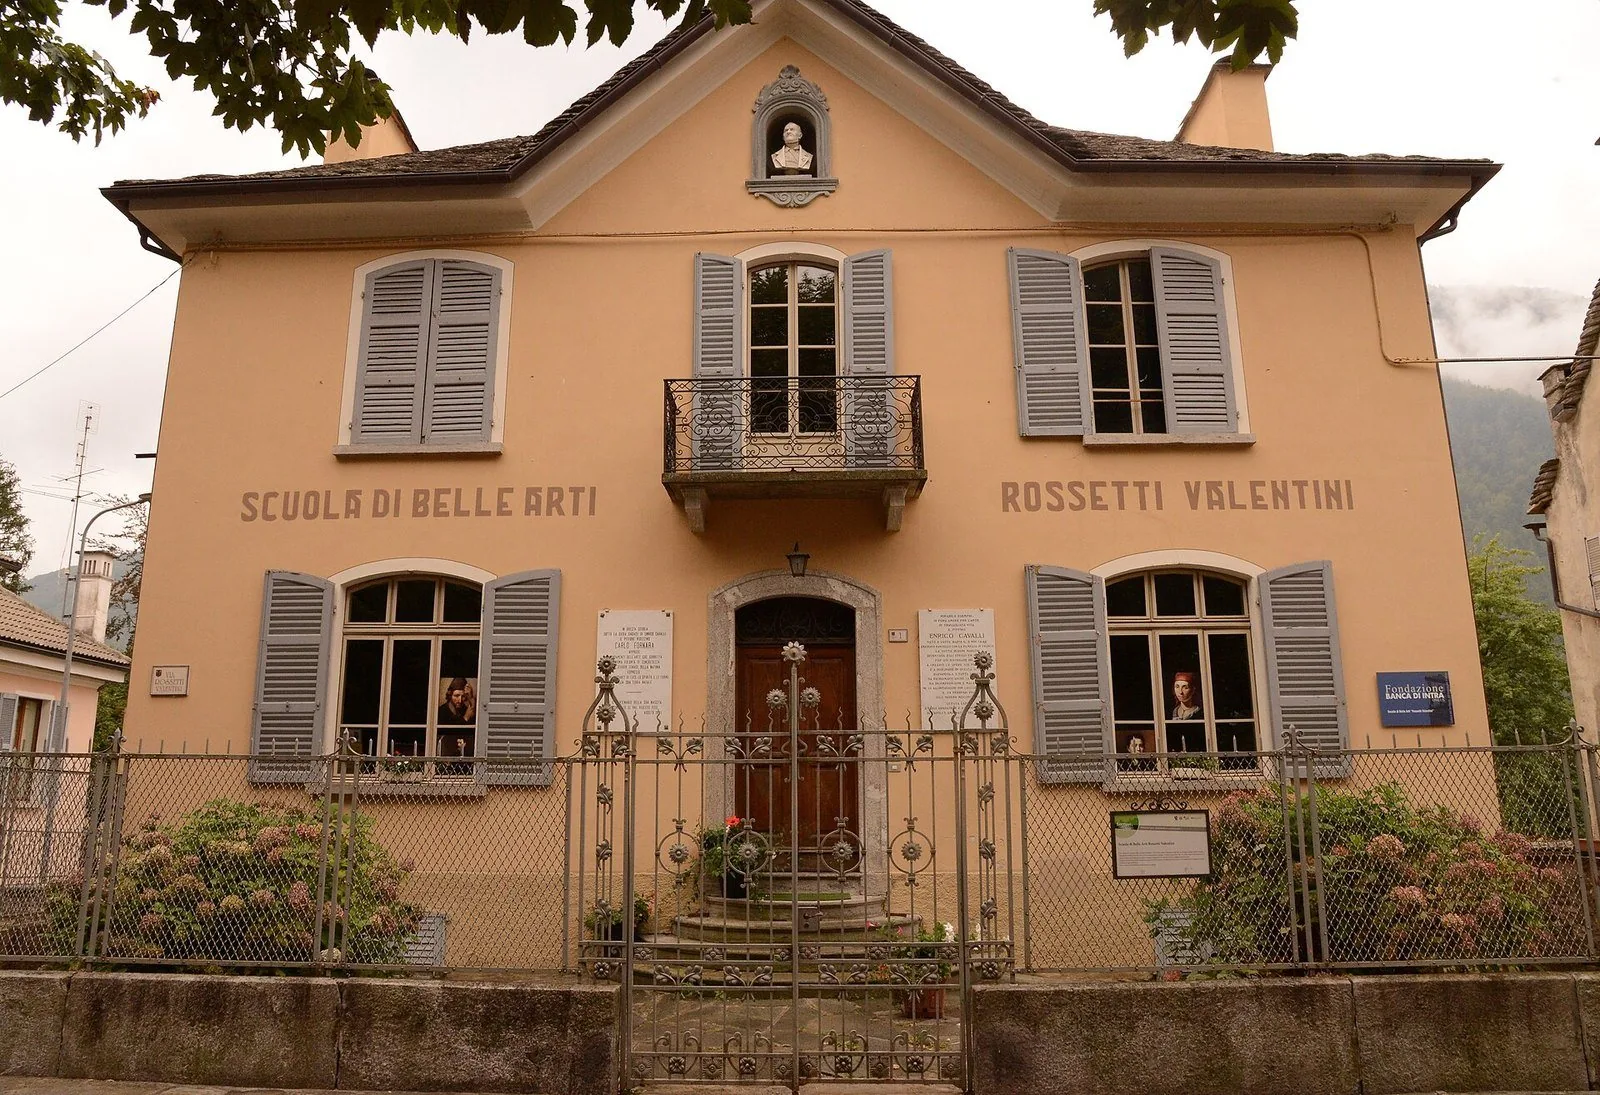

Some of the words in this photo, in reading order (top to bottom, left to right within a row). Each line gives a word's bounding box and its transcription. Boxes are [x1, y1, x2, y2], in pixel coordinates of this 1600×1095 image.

[1001, 480, 1164, 512] ROSSETTI
[1183, 479, 1355, 511] VALENTINI
[240, 489, 362, 522] SCUOLA
[371, 488, 402, 518] DI
[411, 487, 514, 519] BELLE
[524, 486, 597, 517] ARTI
[614, 641, 630, 649] CARLO
[1385, 684, 1444, 693] Fondazione
[1385, 692, 1412, 700] BANCA
